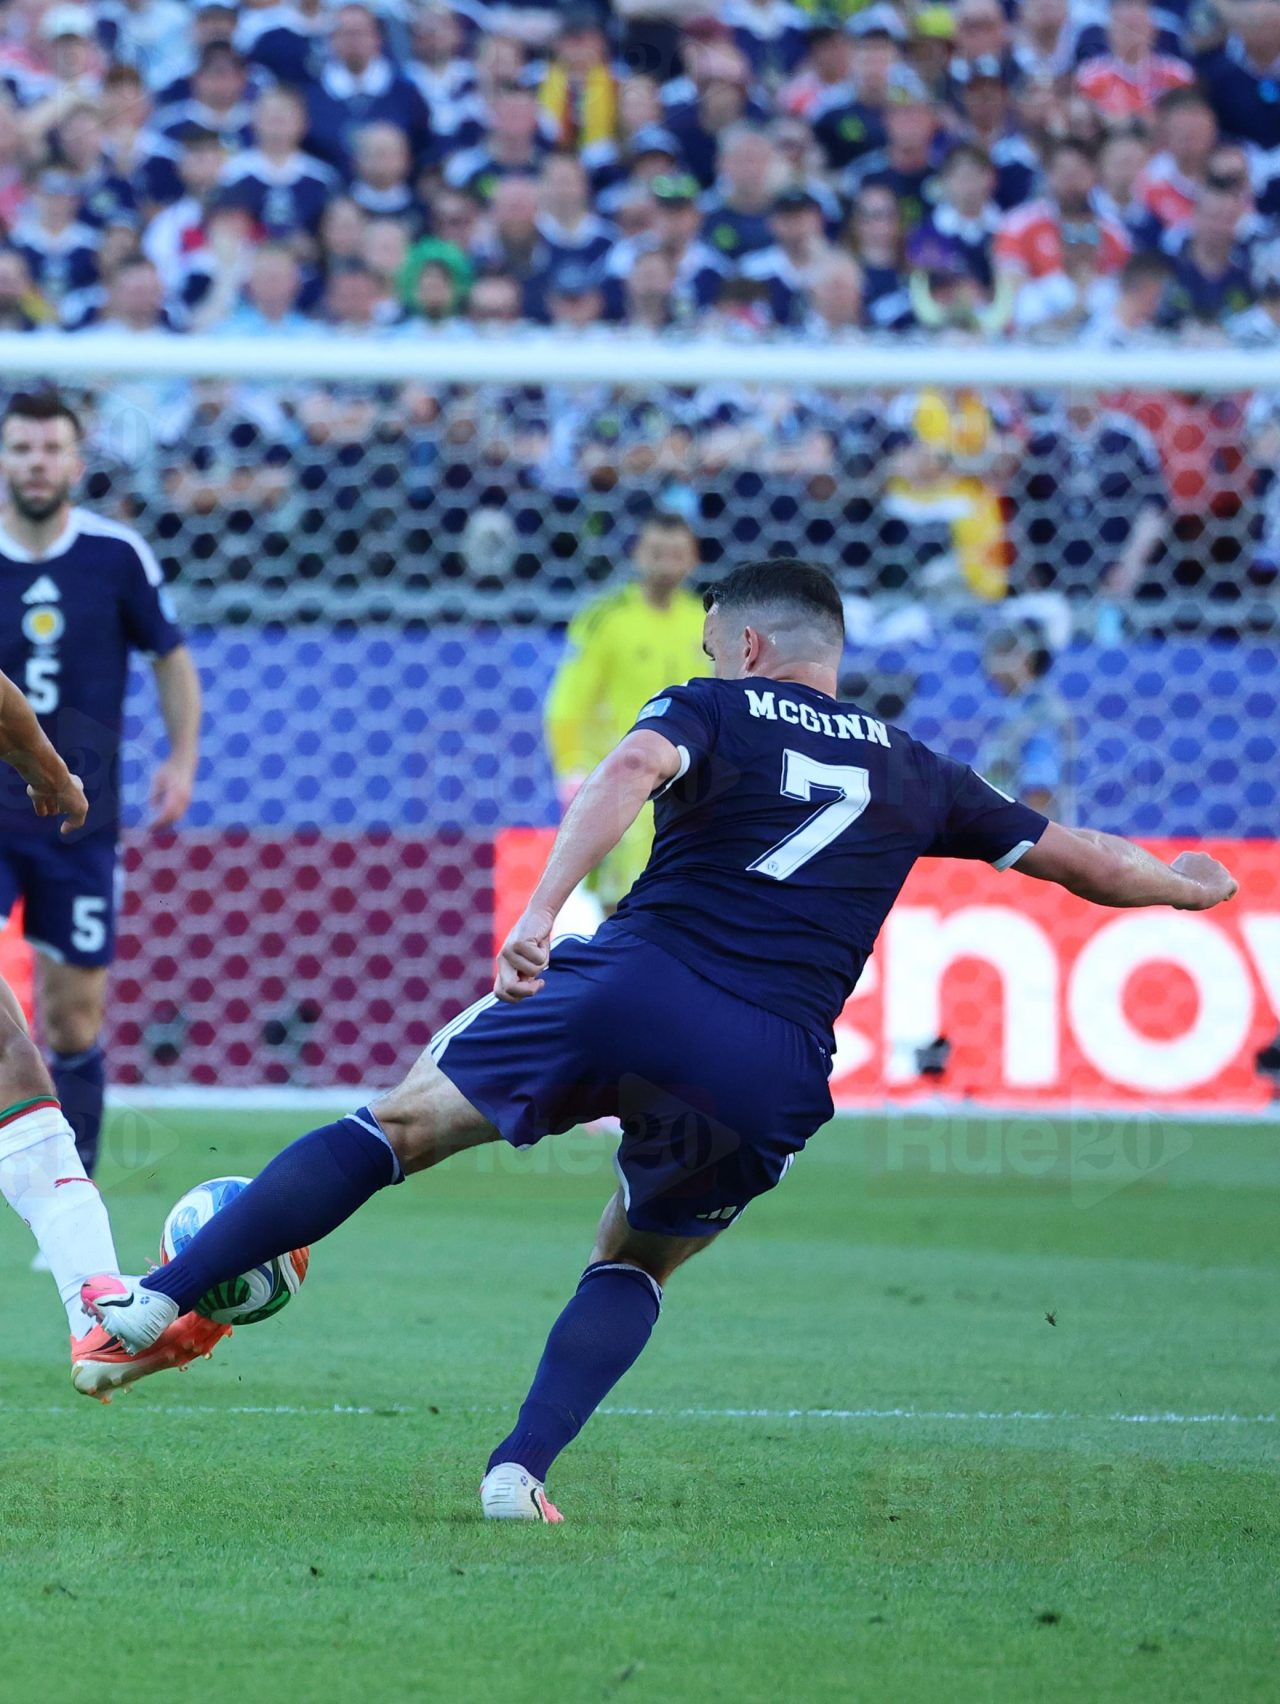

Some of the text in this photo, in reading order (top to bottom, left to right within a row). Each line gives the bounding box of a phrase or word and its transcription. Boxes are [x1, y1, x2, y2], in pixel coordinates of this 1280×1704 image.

[25, 656, 61, 714] 5
[745, 748, 872, 881] 7
[70, 894, 108, 953] 5
